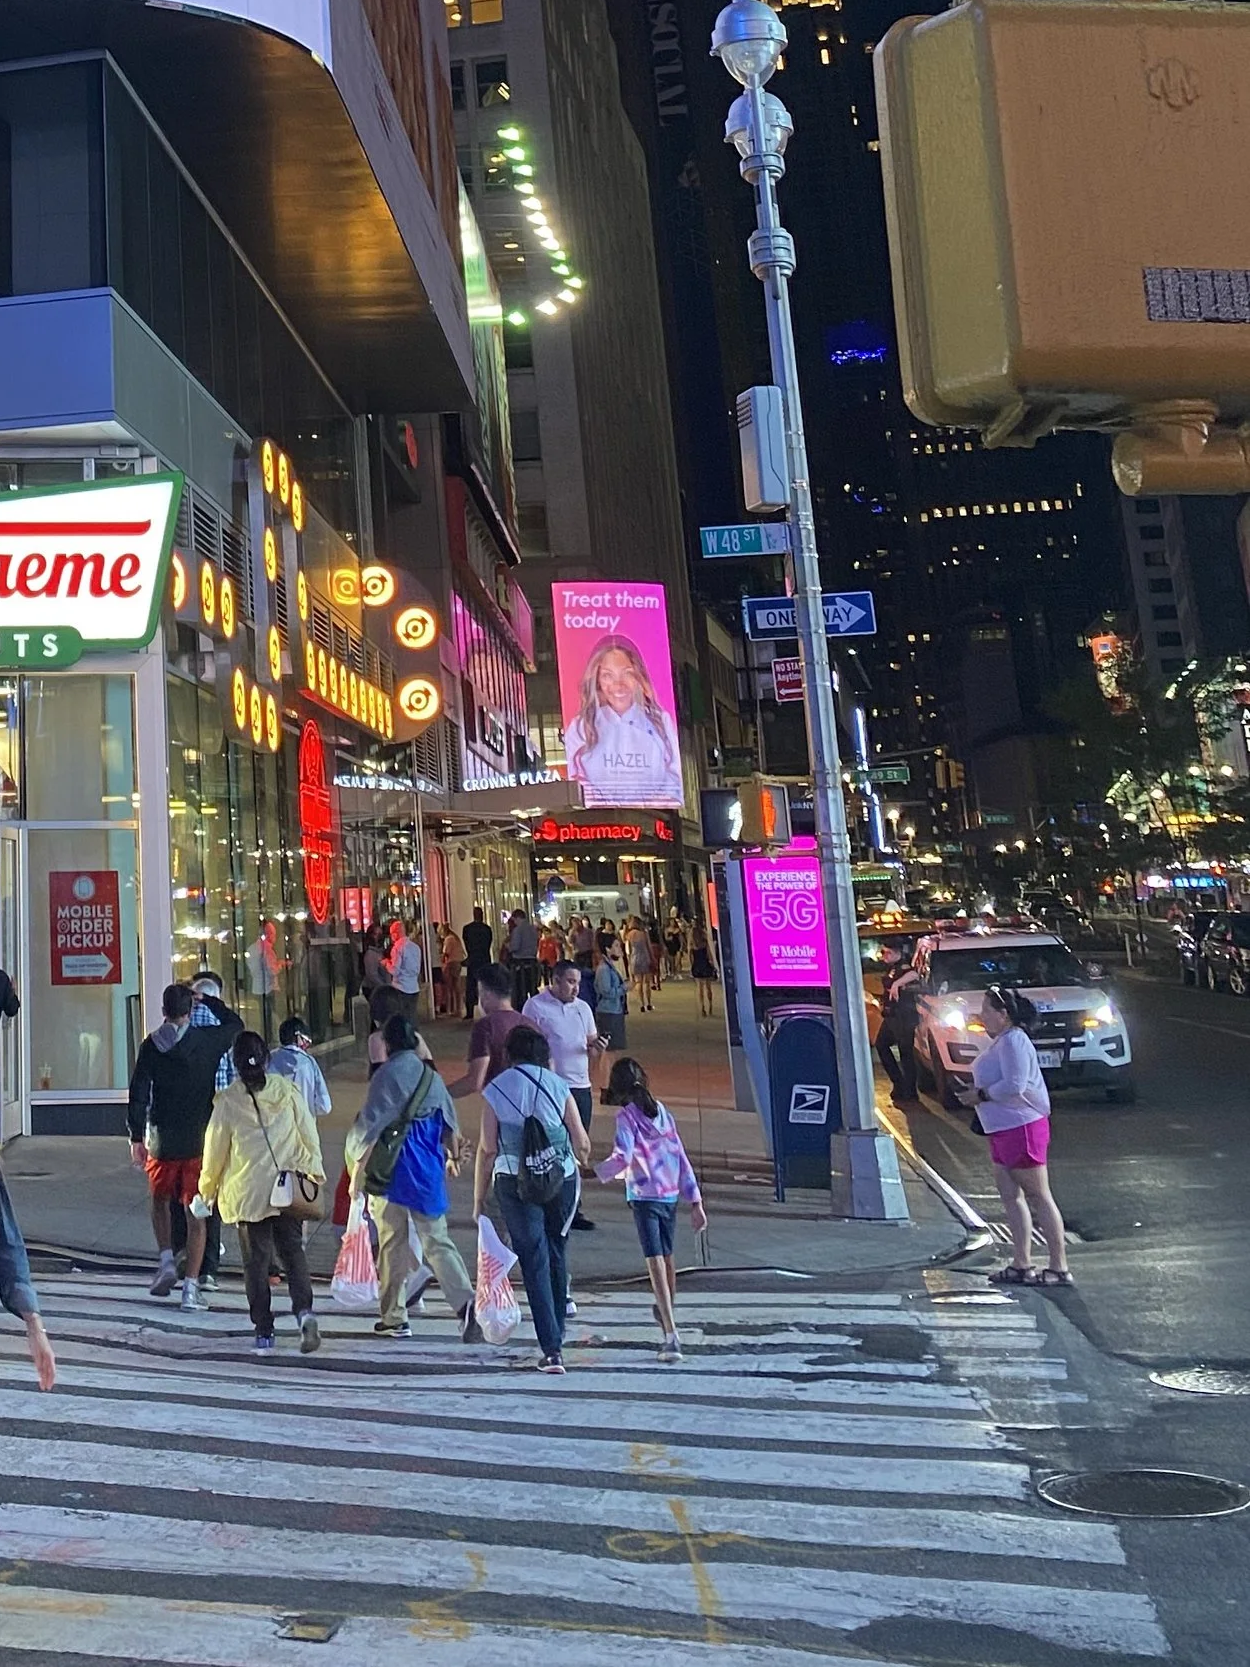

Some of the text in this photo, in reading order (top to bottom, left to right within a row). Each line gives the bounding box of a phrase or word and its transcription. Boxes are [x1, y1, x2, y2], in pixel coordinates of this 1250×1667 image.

[705, 527, 757, 554] W 48 ST
[562, 590, 660, 610] Treat them
[563, 610, 621, 633] today
[766, 608, 798, 627] ONE
[777, 672, 803, 683] Anytim
[603, 753, 651, 768] HAZEL
[462, 768, 563, 793] CROWNE PLAZA
[886, 770, 899, 780] St
[559, 822, 642, 843] pharmacy
[754, 871, 818, 882] EXPERIENCE
[755, 881, 818, 891] THE POWER OF
[57, 904, 114, 919] MOBILE
[761, 890, 820, 931] 5G
[56, 918, 114, 934] ORDER
[57, 933, 114, 949] PICKUP
[779, 944, 817, 958] Mobile
